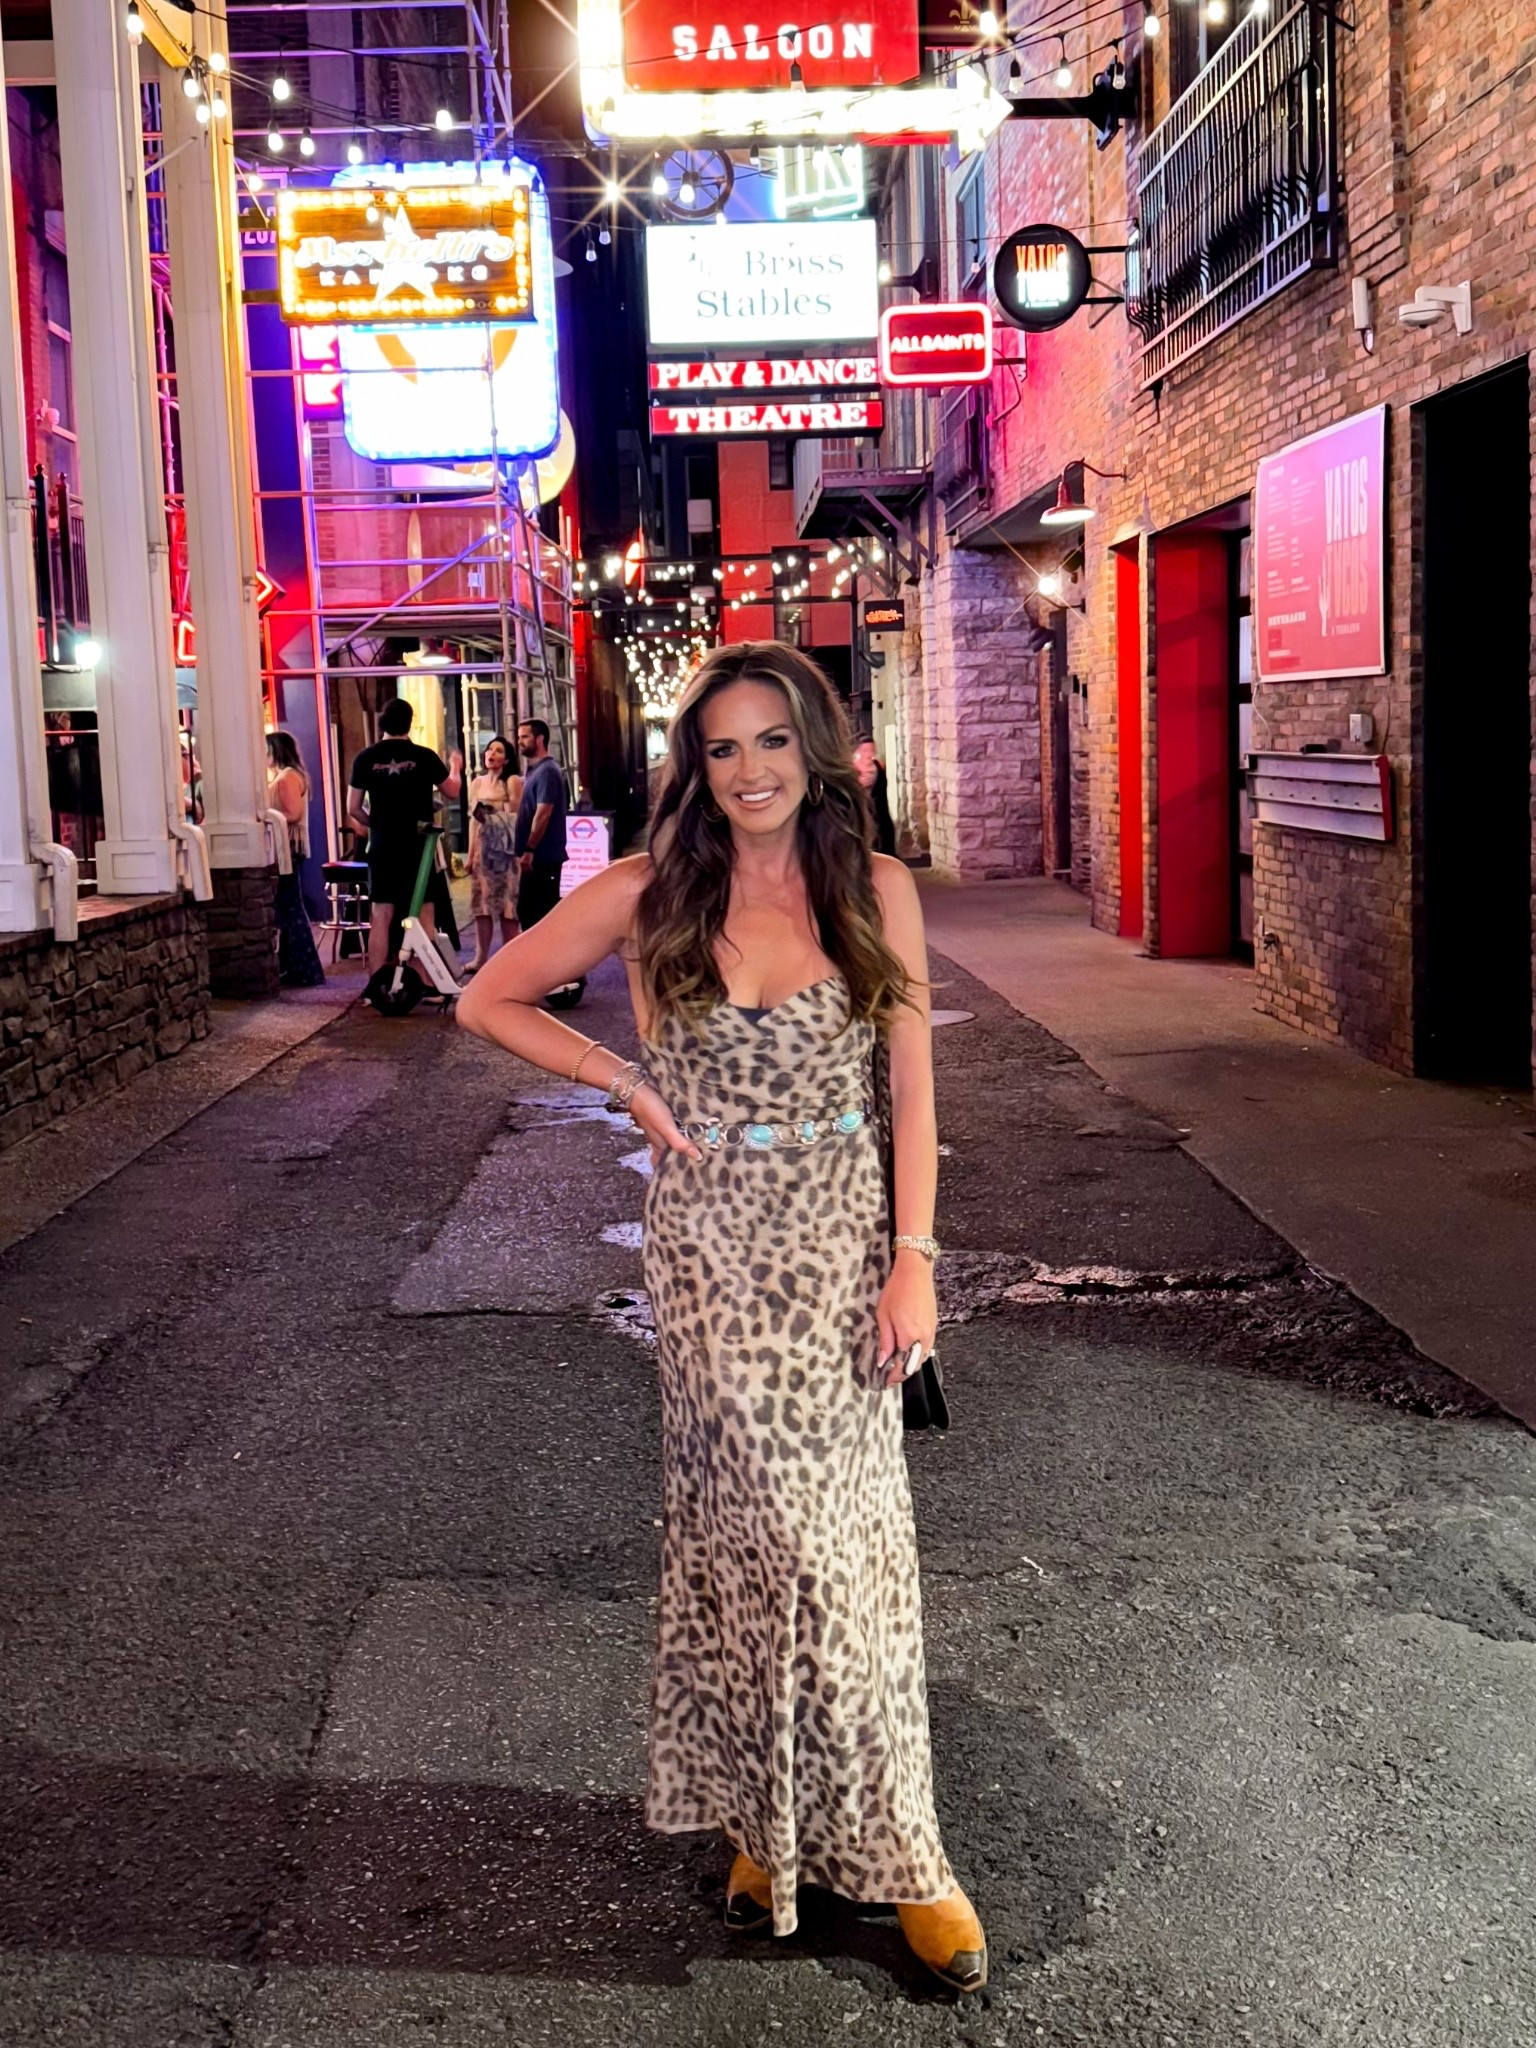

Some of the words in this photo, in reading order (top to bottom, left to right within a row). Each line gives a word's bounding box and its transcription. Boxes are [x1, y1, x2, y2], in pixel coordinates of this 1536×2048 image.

[672, 23, 873, 60] SALOON
[319, 265, 489, 287] KAOKE
[745, 249, 844, 277] Brass
[697, 287, 832, 318] Stables
[890, 332, 986, 353] ALLSAINTS
[656, 362, 737, 389] PLAY
[741, 360, 765, 387] &
[770, 358, 877, 386] DANCE
[668, 402, 868, 433] THEATRE
[1324, 455, 1368, 545] VATOS
